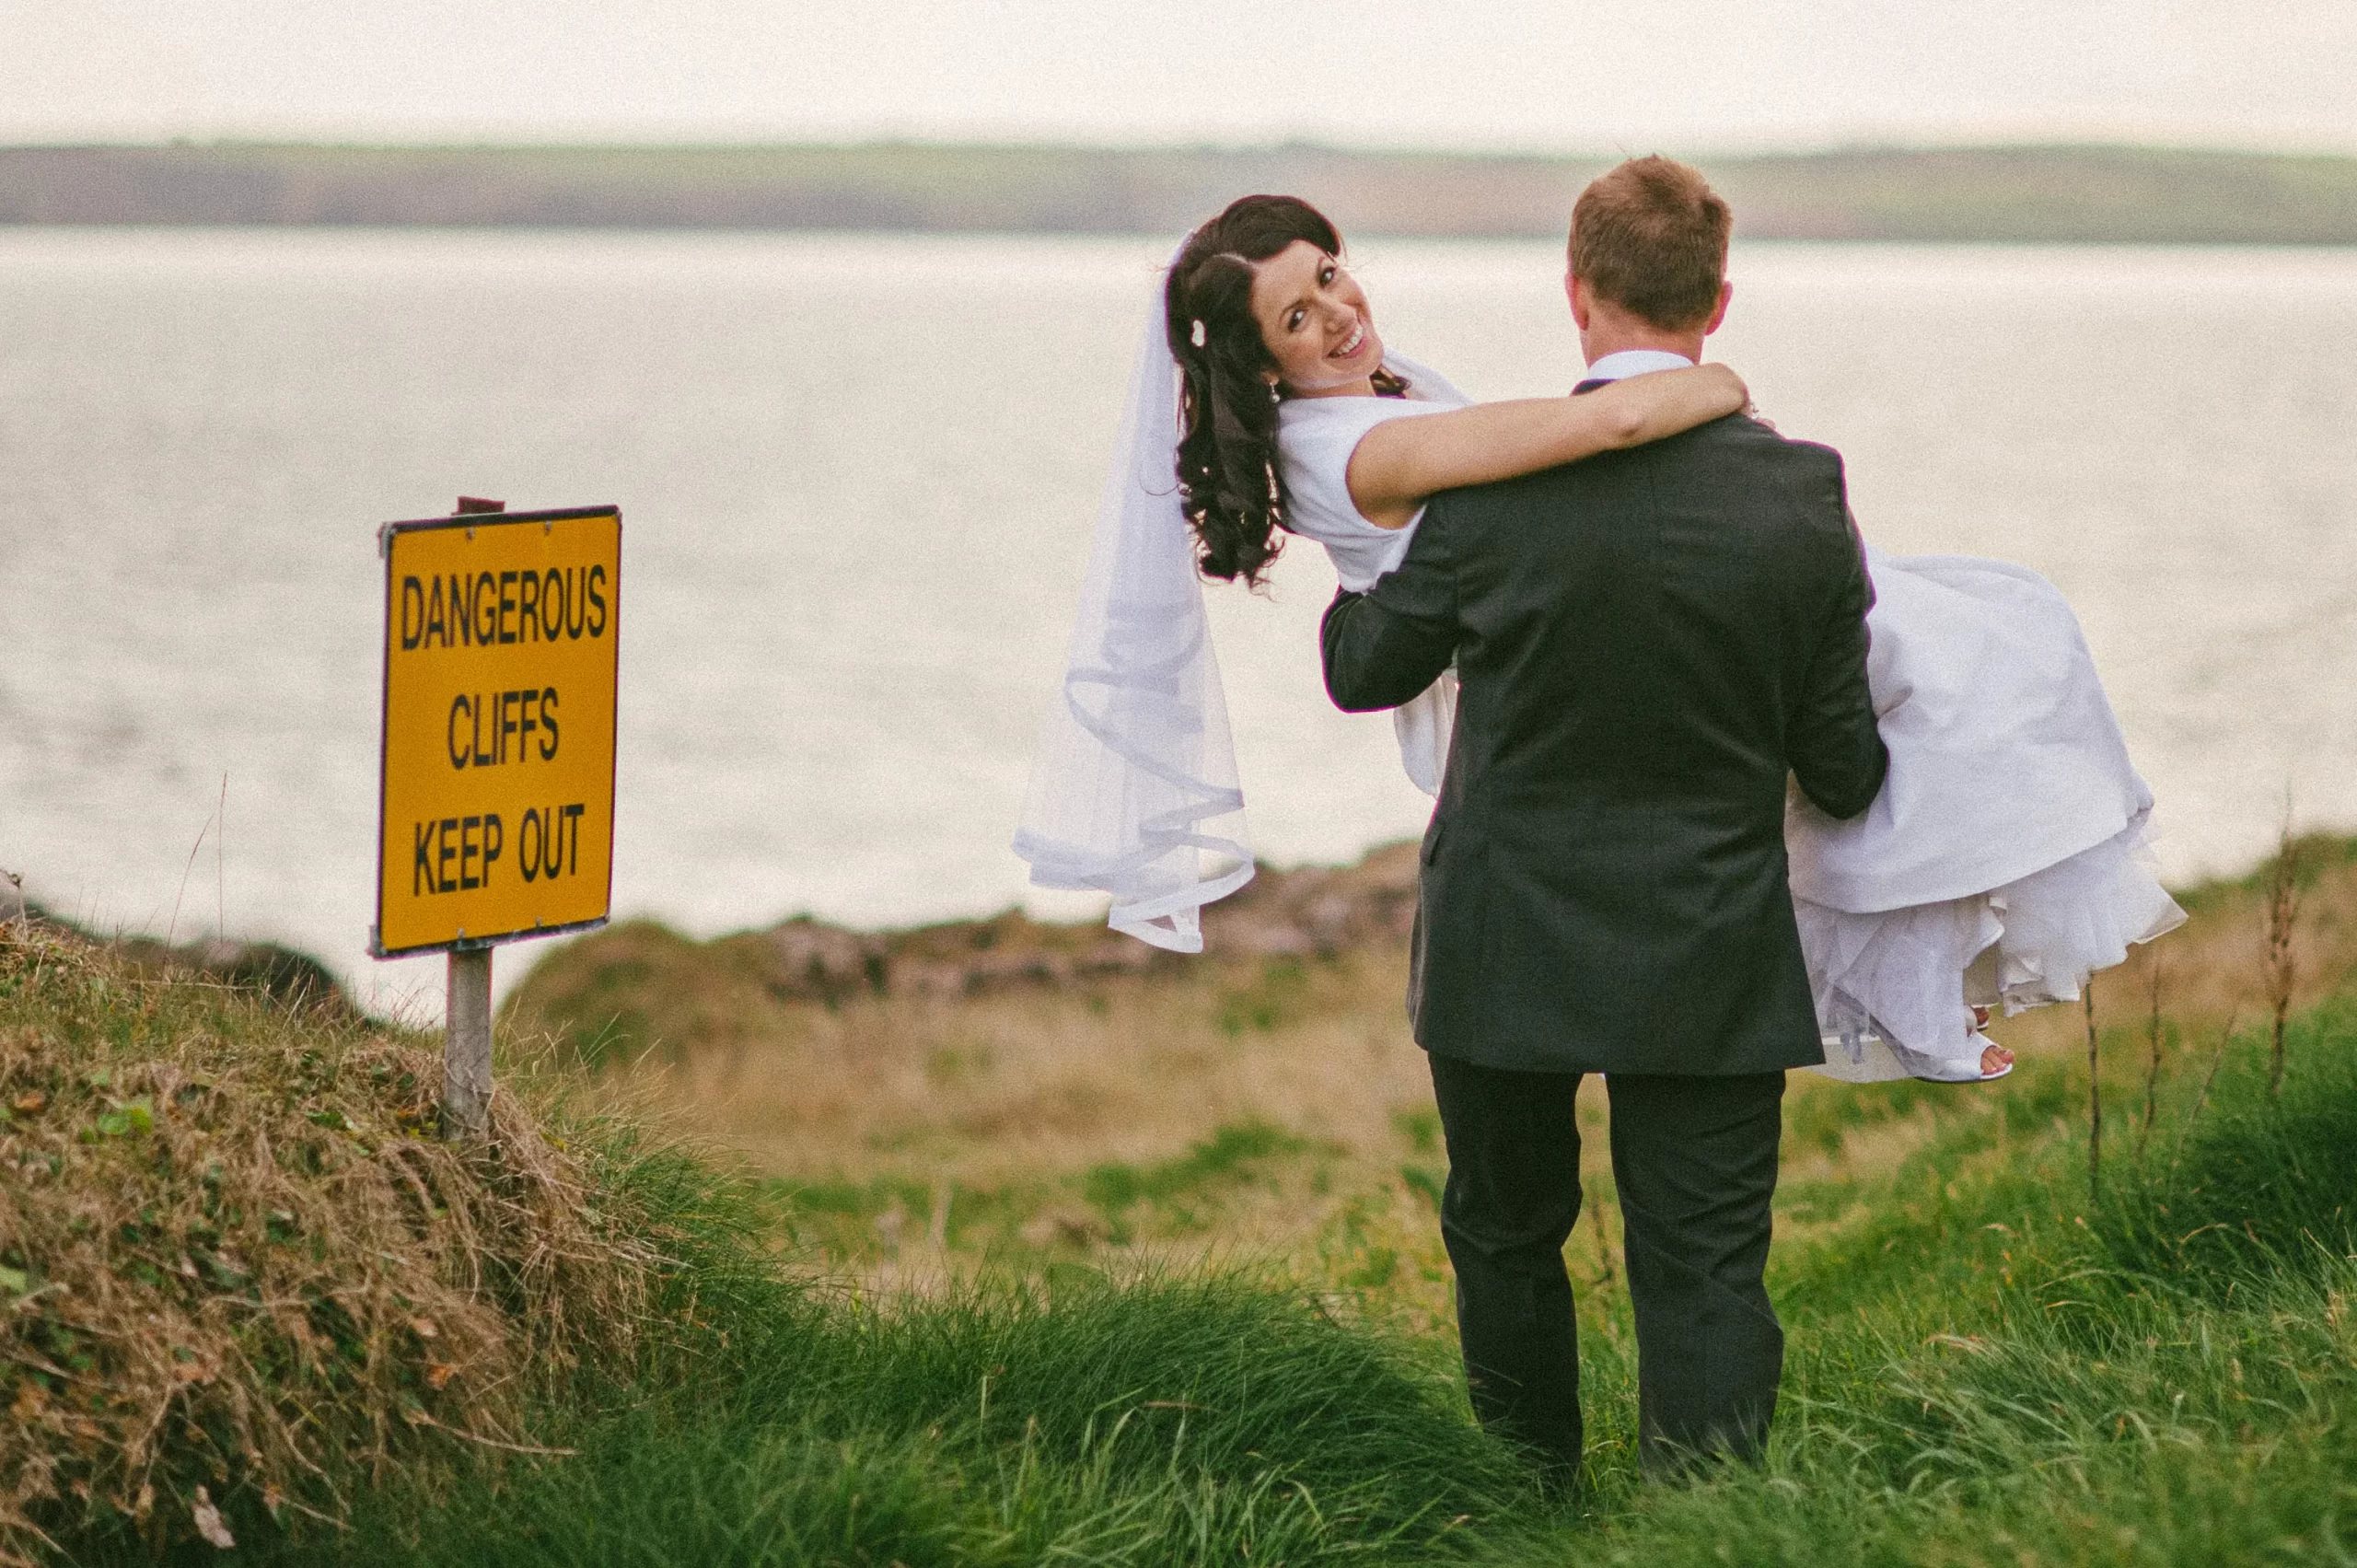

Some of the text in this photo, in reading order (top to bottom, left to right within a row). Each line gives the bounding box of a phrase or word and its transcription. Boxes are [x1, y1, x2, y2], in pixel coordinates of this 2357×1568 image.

[401, 563, 607, 651] DANGEROUS
[448, 686, 559, 771] CLIFFS
[414, 803, 586, 897] KEEP OUT
